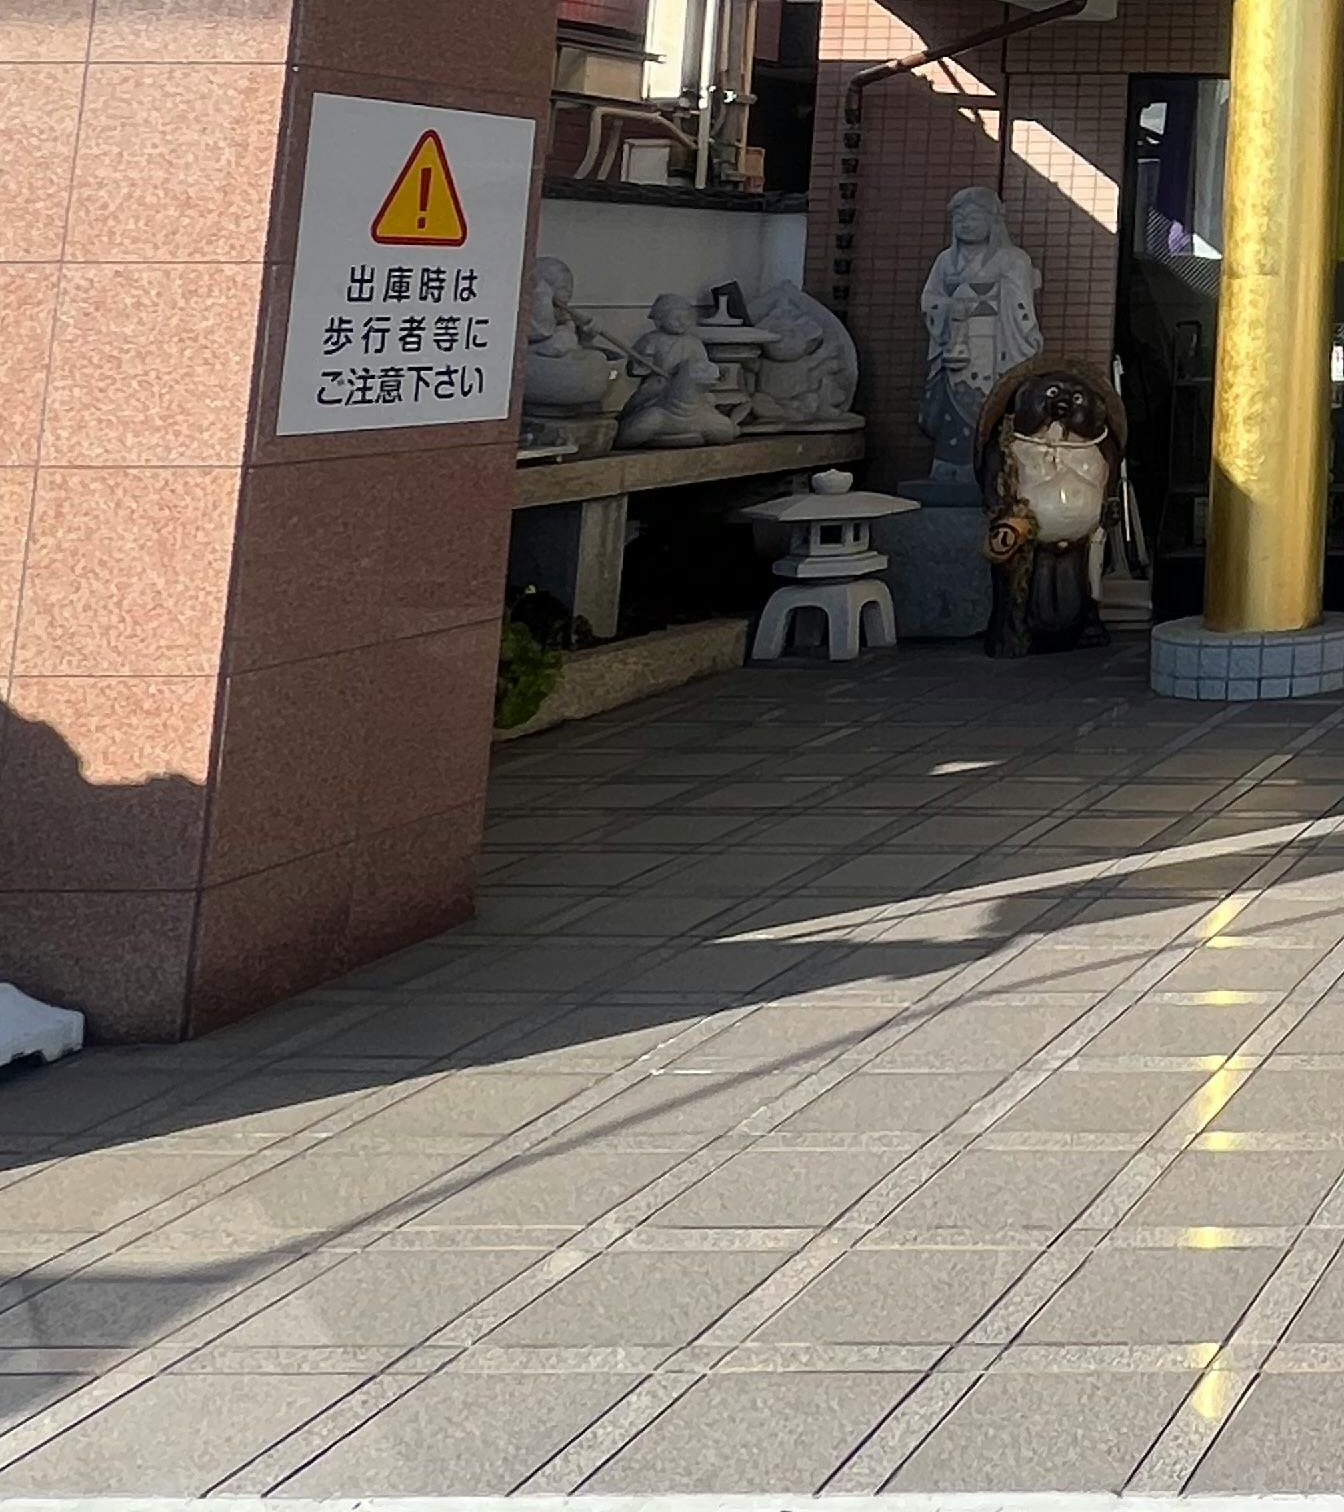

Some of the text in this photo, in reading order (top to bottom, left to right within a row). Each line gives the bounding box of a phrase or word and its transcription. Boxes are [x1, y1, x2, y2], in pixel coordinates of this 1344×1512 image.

[346, 264, 478, 303] 出庫時は
[323, 315, 490, 355] 歩行者等に
[316, 364, 484, 407] ご注意下さい
